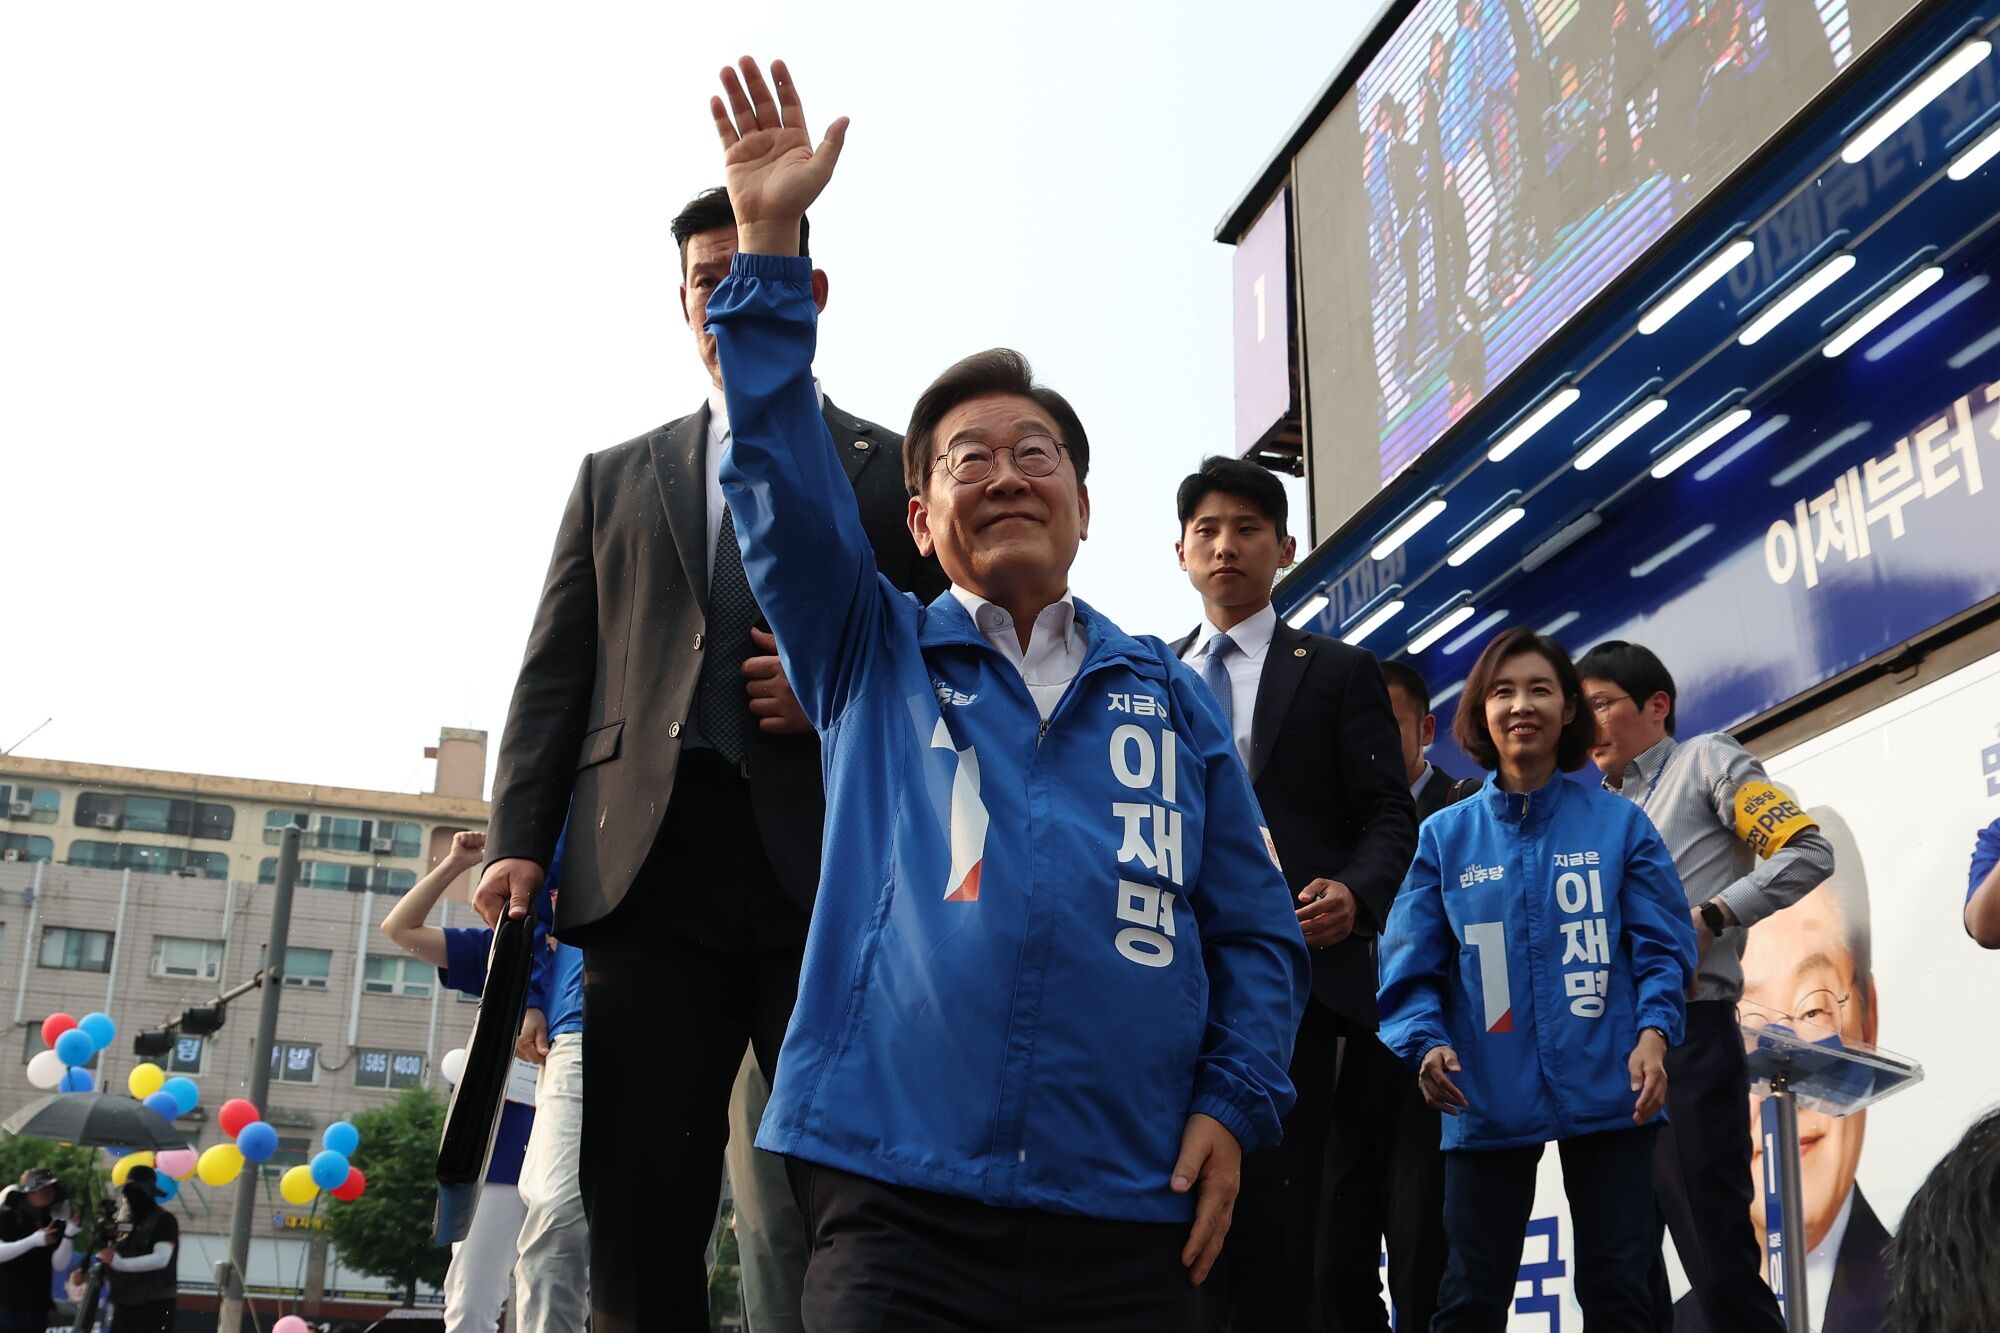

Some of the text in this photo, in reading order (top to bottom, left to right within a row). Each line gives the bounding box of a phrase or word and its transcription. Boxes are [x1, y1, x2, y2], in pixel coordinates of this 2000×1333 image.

[1253, 272, 1266, 344] 1
[1765, 395, 1984, 590] 이제부터
[1109, 723, 1184, 968] 이재명
[1459, 865, 1504, 889] 민주당
[1553, 851, 1600, 868] 지금은
[1464, 921, 1513, 1032] 1
[1556, 869, 1611, 1018] 이재명
[1765, 1133, 1776, 1194] 1
